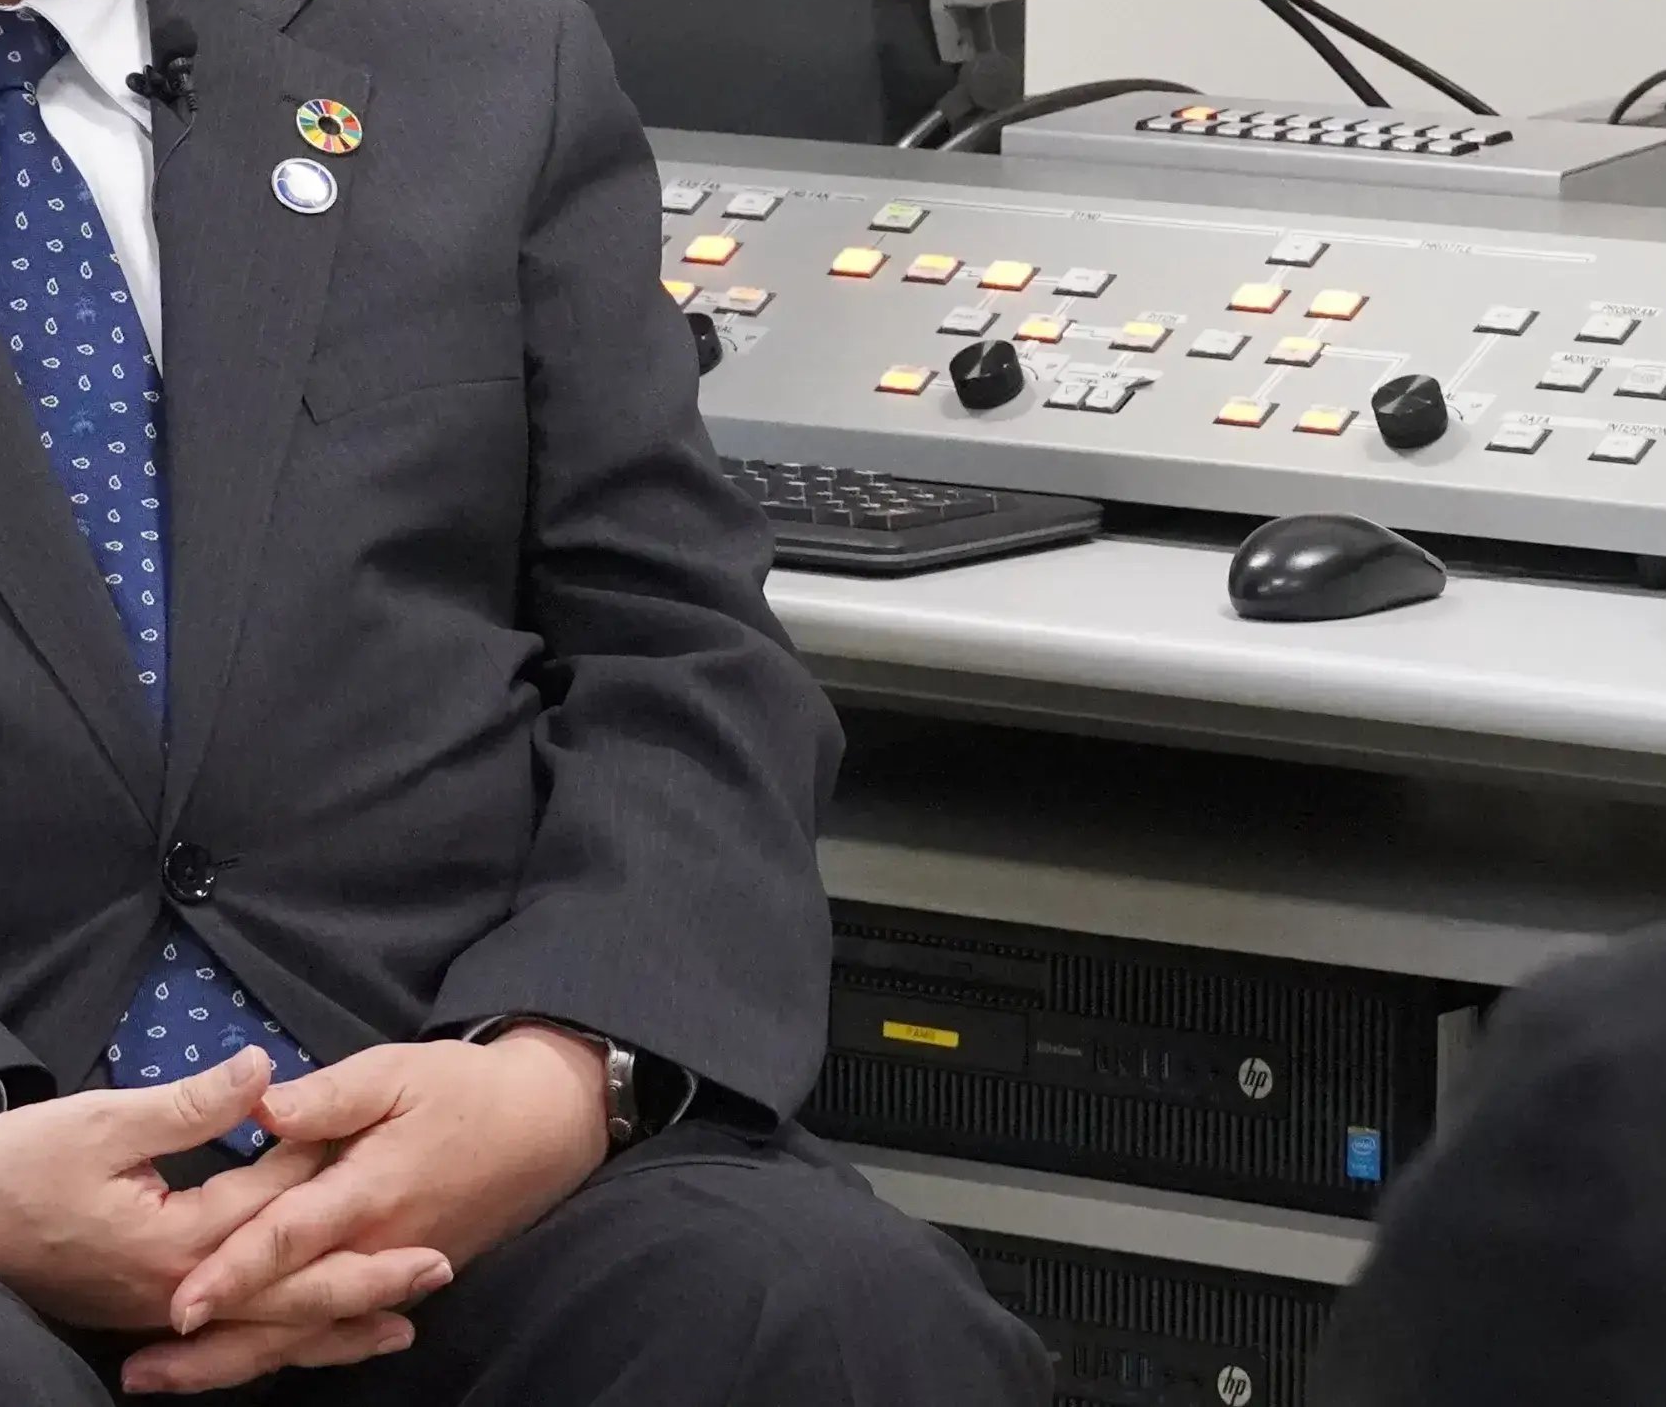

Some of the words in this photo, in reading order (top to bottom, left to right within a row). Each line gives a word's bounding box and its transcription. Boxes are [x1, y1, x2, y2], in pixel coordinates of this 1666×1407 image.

[1602, 303, 1658, 318] PROGRAM
[1563, 353, 1611, 367] MONITOR
[1518, 414, 1551, 425] DATA
[1242, 1057, 1269, 1100] hp
[1222, 1364, 1247, 1407] hp
